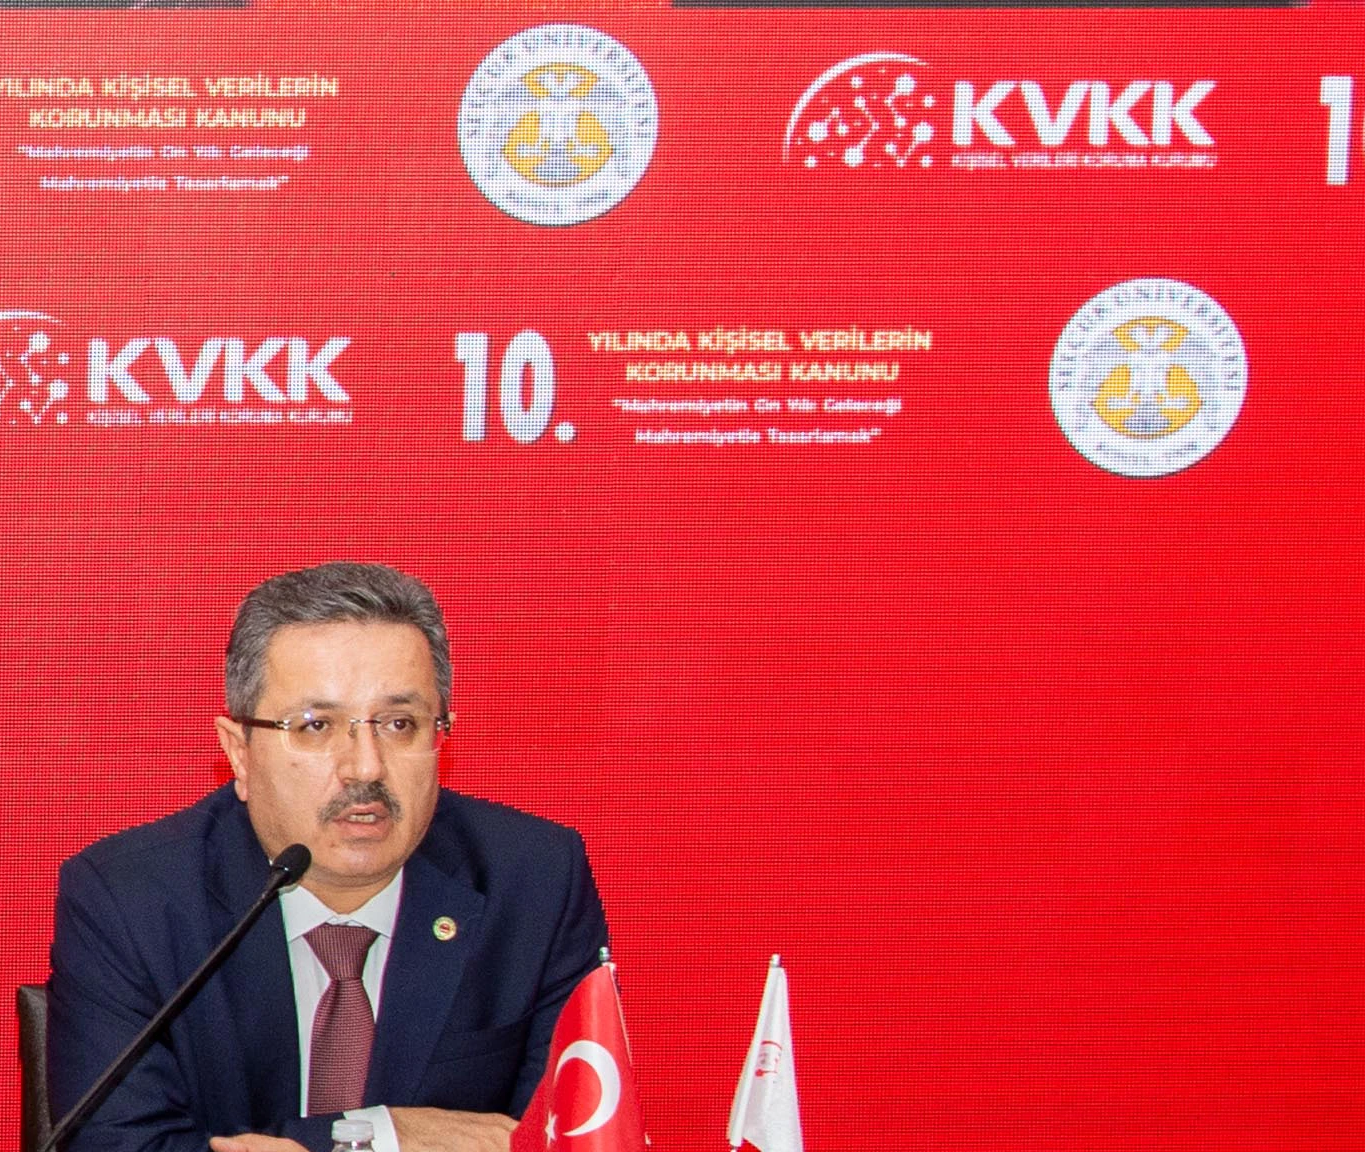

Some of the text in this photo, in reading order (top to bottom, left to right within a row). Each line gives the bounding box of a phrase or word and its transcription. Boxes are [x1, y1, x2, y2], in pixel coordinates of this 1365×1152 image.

[102, 75, 195, 100] KİŞİSEL
[205, 75, 337, 97] VERİLERİN
[30, 108, 305, 127] KORUNMASI KANUNU
[953, 81, 1214, 146] KVKK
[589, 328, 931, 354] YILINDA KİŞİSEL VERİLERİN
[88, 338, 349, 403] KVKK
[626, 363, 899, 381] KORUNMASI KANUNU
[455, 330, 574, 442] 10.
